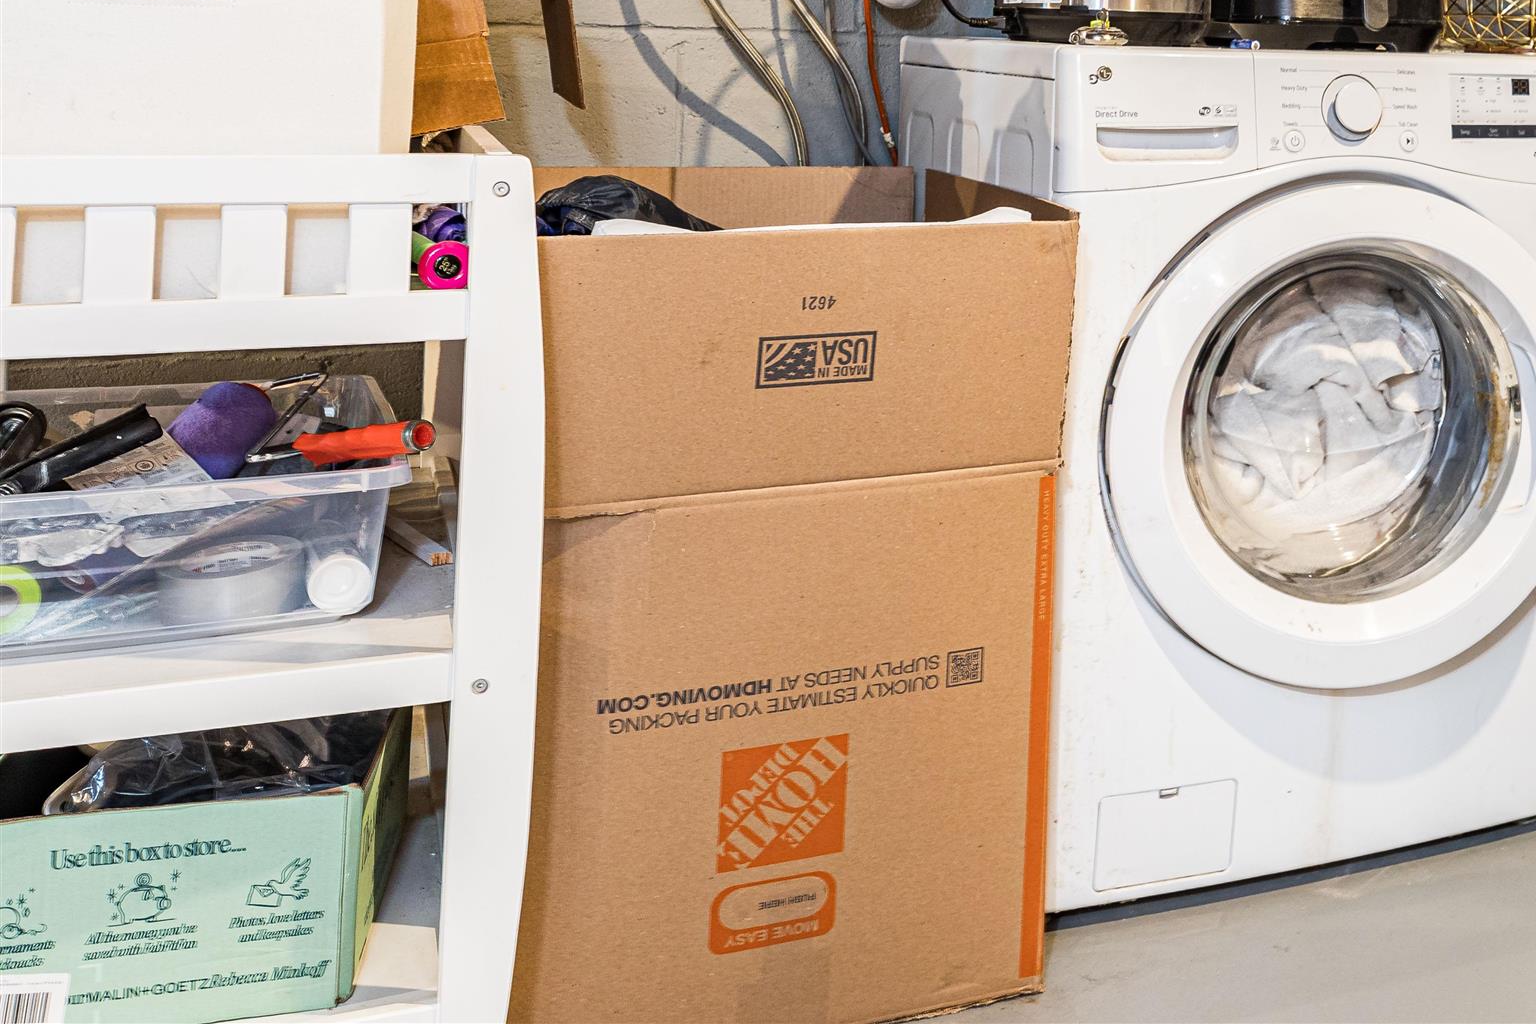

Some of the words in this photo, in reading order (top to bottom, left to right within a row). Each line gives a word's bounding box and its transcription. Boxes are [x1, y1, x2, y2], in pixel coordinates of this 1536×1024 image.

[1095, 110, 1118, 118] Direct
[1119, 110, 1139, 118] Drive
[802, 295, 837, 311] 4621
[821, 337, 869, 366] USA
[817, 366, 830, 378] IN
[833, 364, 868, 377] MADE
[804, 665, 867, 688] NEEDS
[871, 654, 940, 678] SUPPLY
[776, 674, 800, 692] AT
[862, 674, 940, 699] QUICKLY
[597, 678, 772, 714] HDMOVING.COM
[766, 686, 857, 714] ESTIMATE
[609, 708, 700, 734] PACKING
[705, 701, 762, 722] YOUR
[720, 742, 801, 827] DEPOT
[717, 737, 847, 868] HOME
[780, 798, 835, 848] THE
[50, 848, 87, 870] Use
[87, 844, 124, 867] this
[123, 842, 161, 863] box
[161, 841, 182, 860] to
[292, 909, 325, 922] letters
[723, 928, 769, 948] EASY
[771, 919, 819, 940] MOVE
[86, 978, 209, 1003] MALIN+GOETZ
[208, 971, 269, 988] Rebecca
[269, 959, 332, 981] Minkoff
